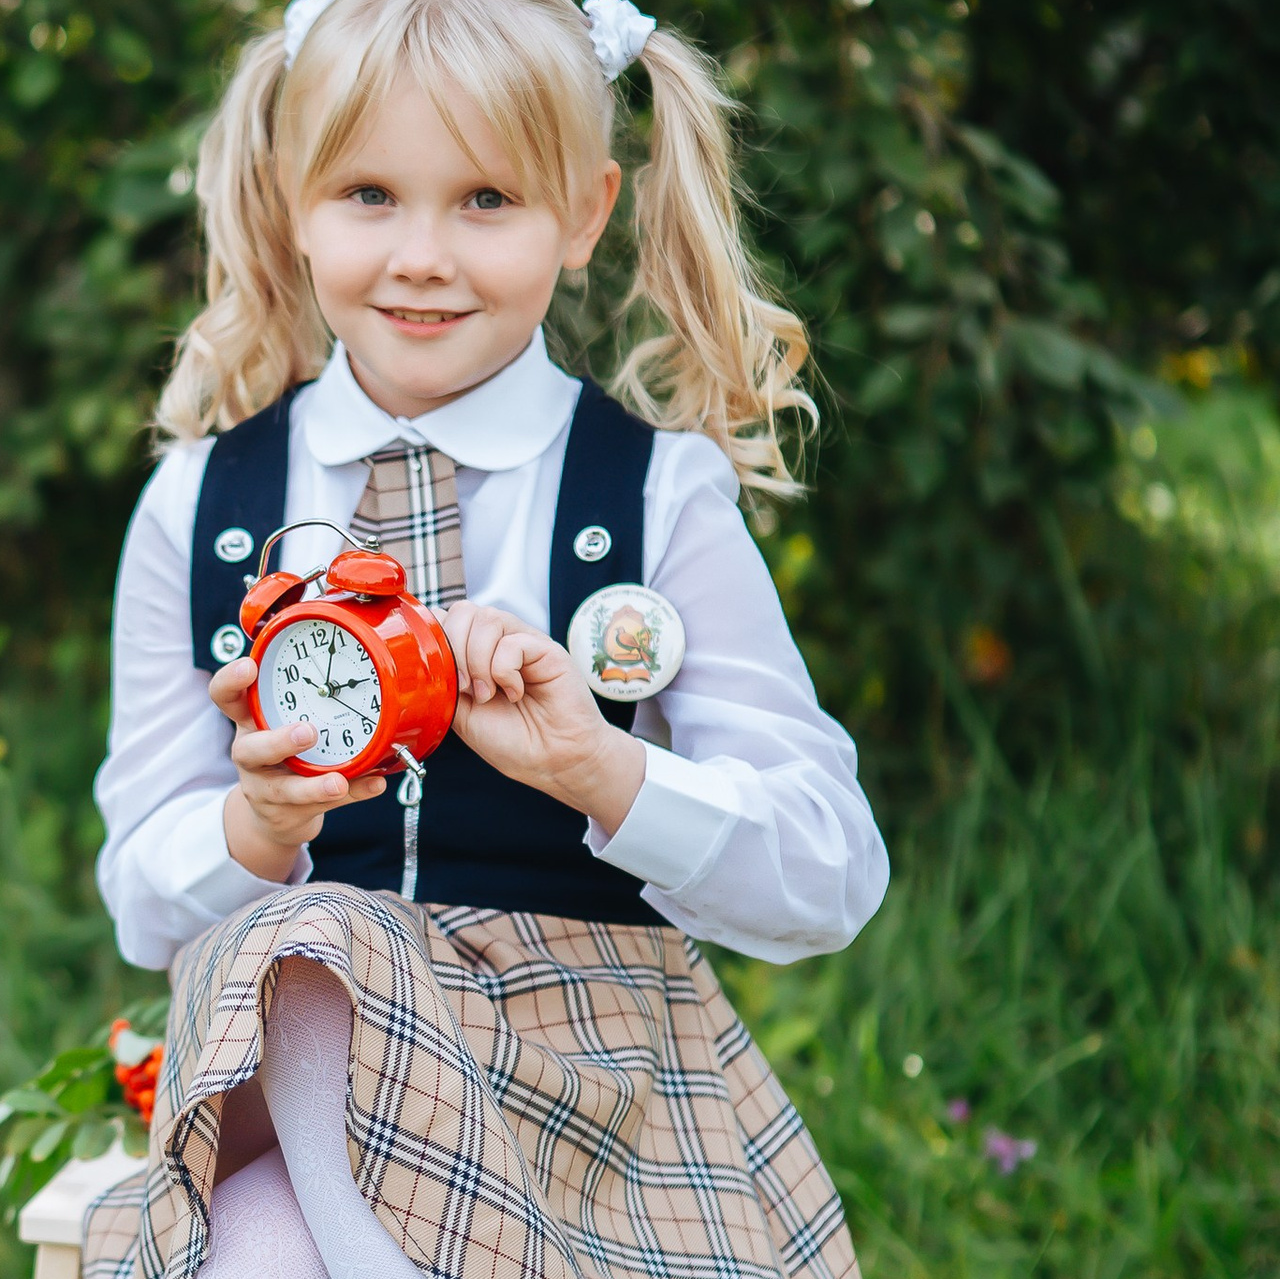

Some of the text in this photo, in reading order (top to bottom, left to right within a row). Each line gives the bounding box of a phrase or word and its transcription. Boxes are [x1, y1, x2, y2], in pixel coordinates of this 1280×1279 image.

[310, 628, 329, 649] 12
[337, 630, 347, 648] 1
[293, 641, 310, 661] 11
[357, 643, 370, 662] 2
[283, 664, 300, 684] 10
[284, 691, 297, 711] 9
[370, 694, 381, 714] 4
[361, 716, 374, 735] 5
[320, 728, 330, 747] 7
[342, 729, 354, 748] 6
